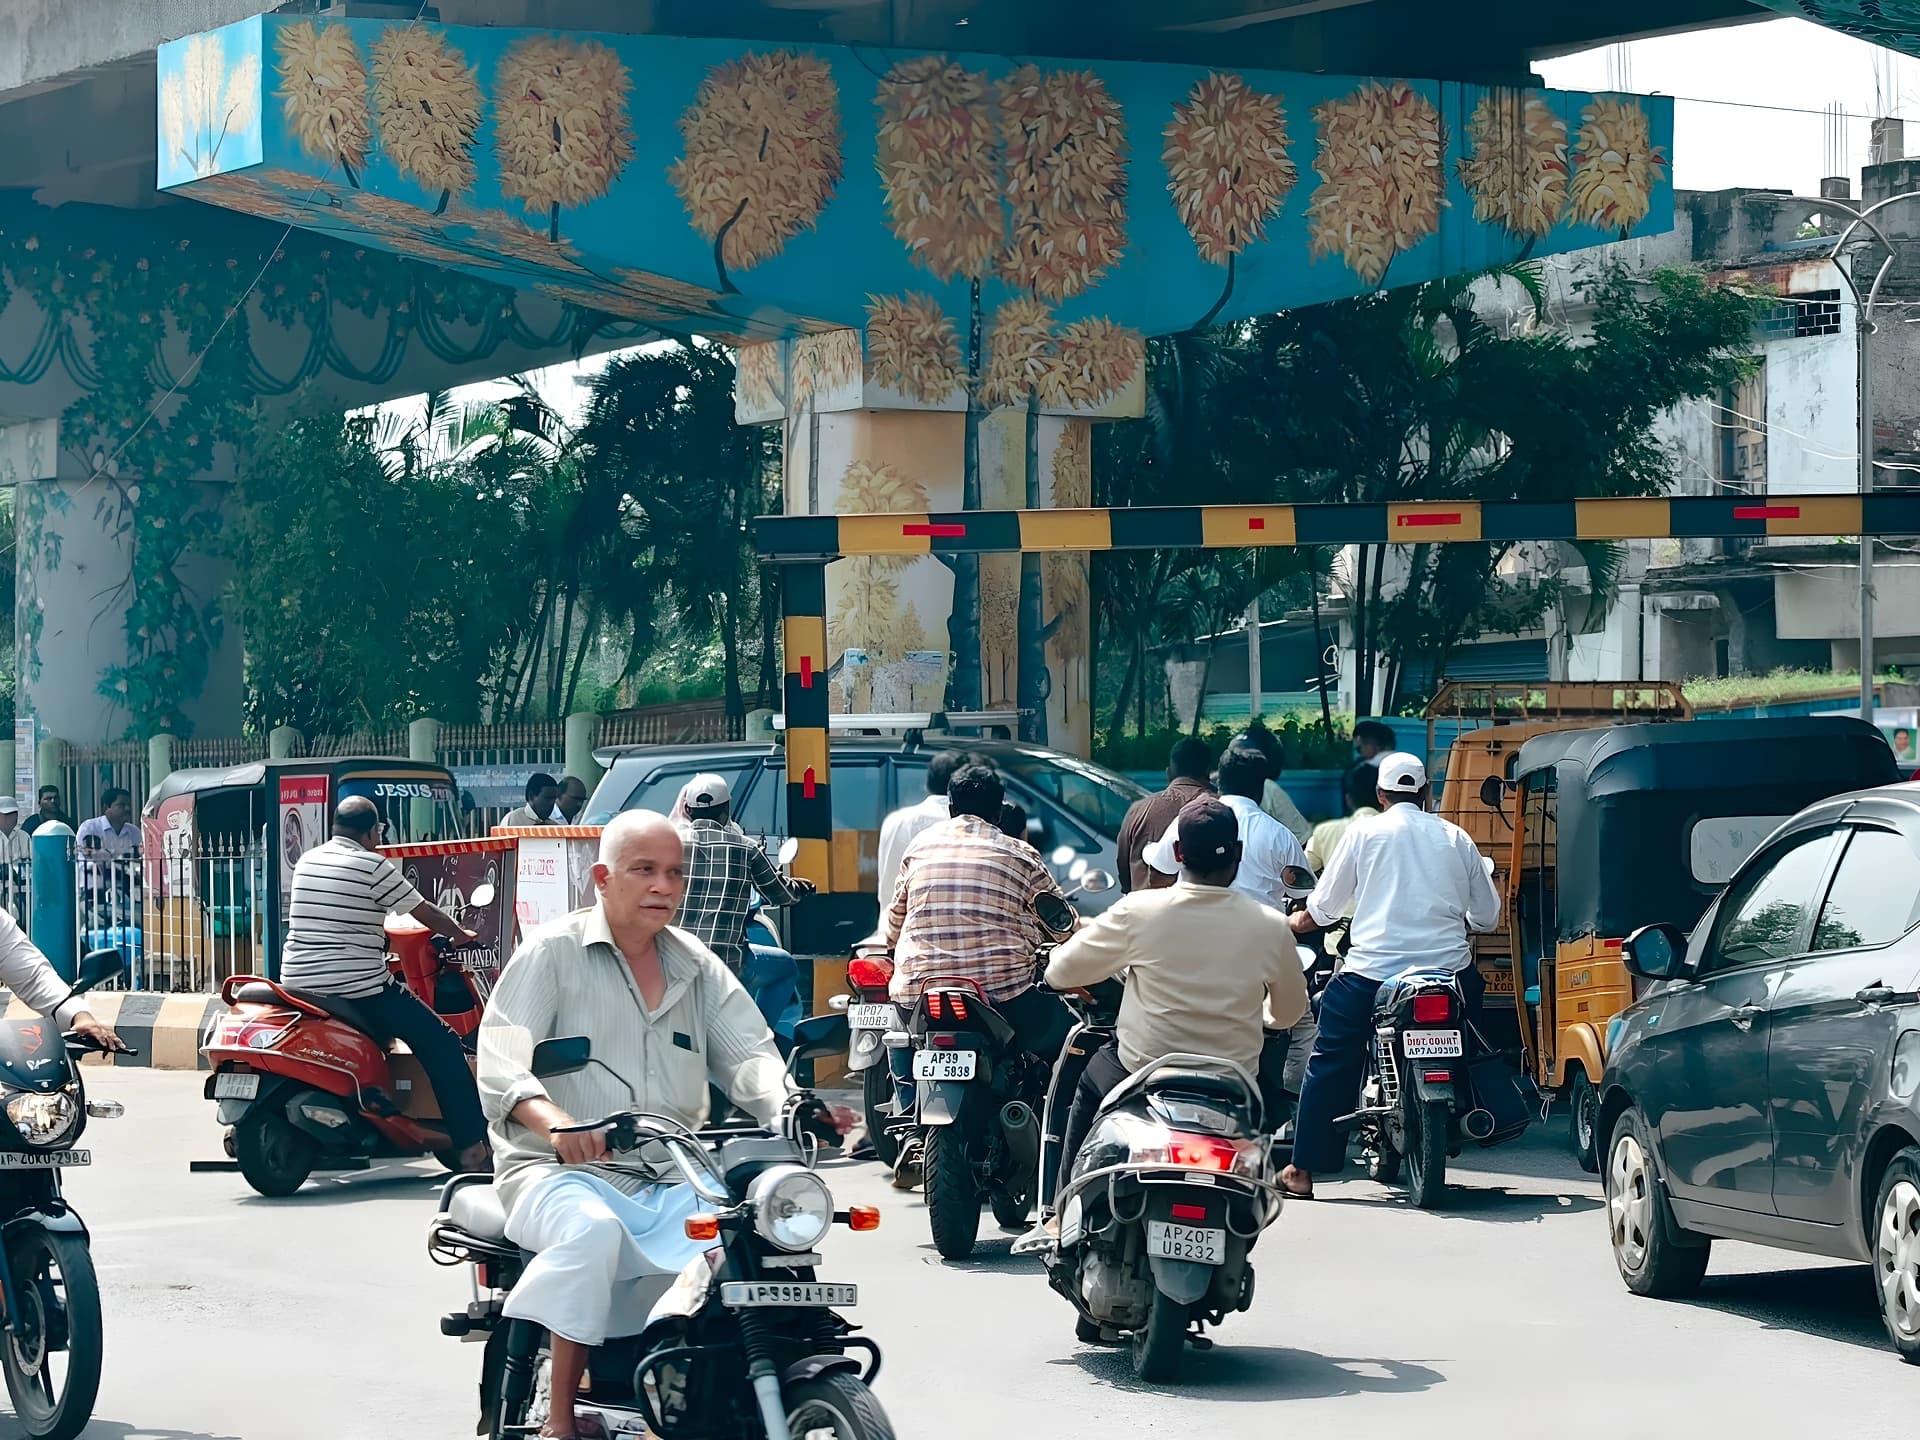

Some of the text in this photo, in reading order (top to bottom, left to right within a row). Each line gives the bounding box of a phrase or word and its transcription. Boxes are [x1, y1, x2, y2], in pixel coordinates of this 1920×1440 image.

[375, 784, 432, 797] JESUS
[1429, 1037, 1457, 1045] COURT
[930, 1052, 959, 1064] AP39
[922, 1066, 935, 1077] EJ
[1162, 1240, 1215, 1261] U8232
